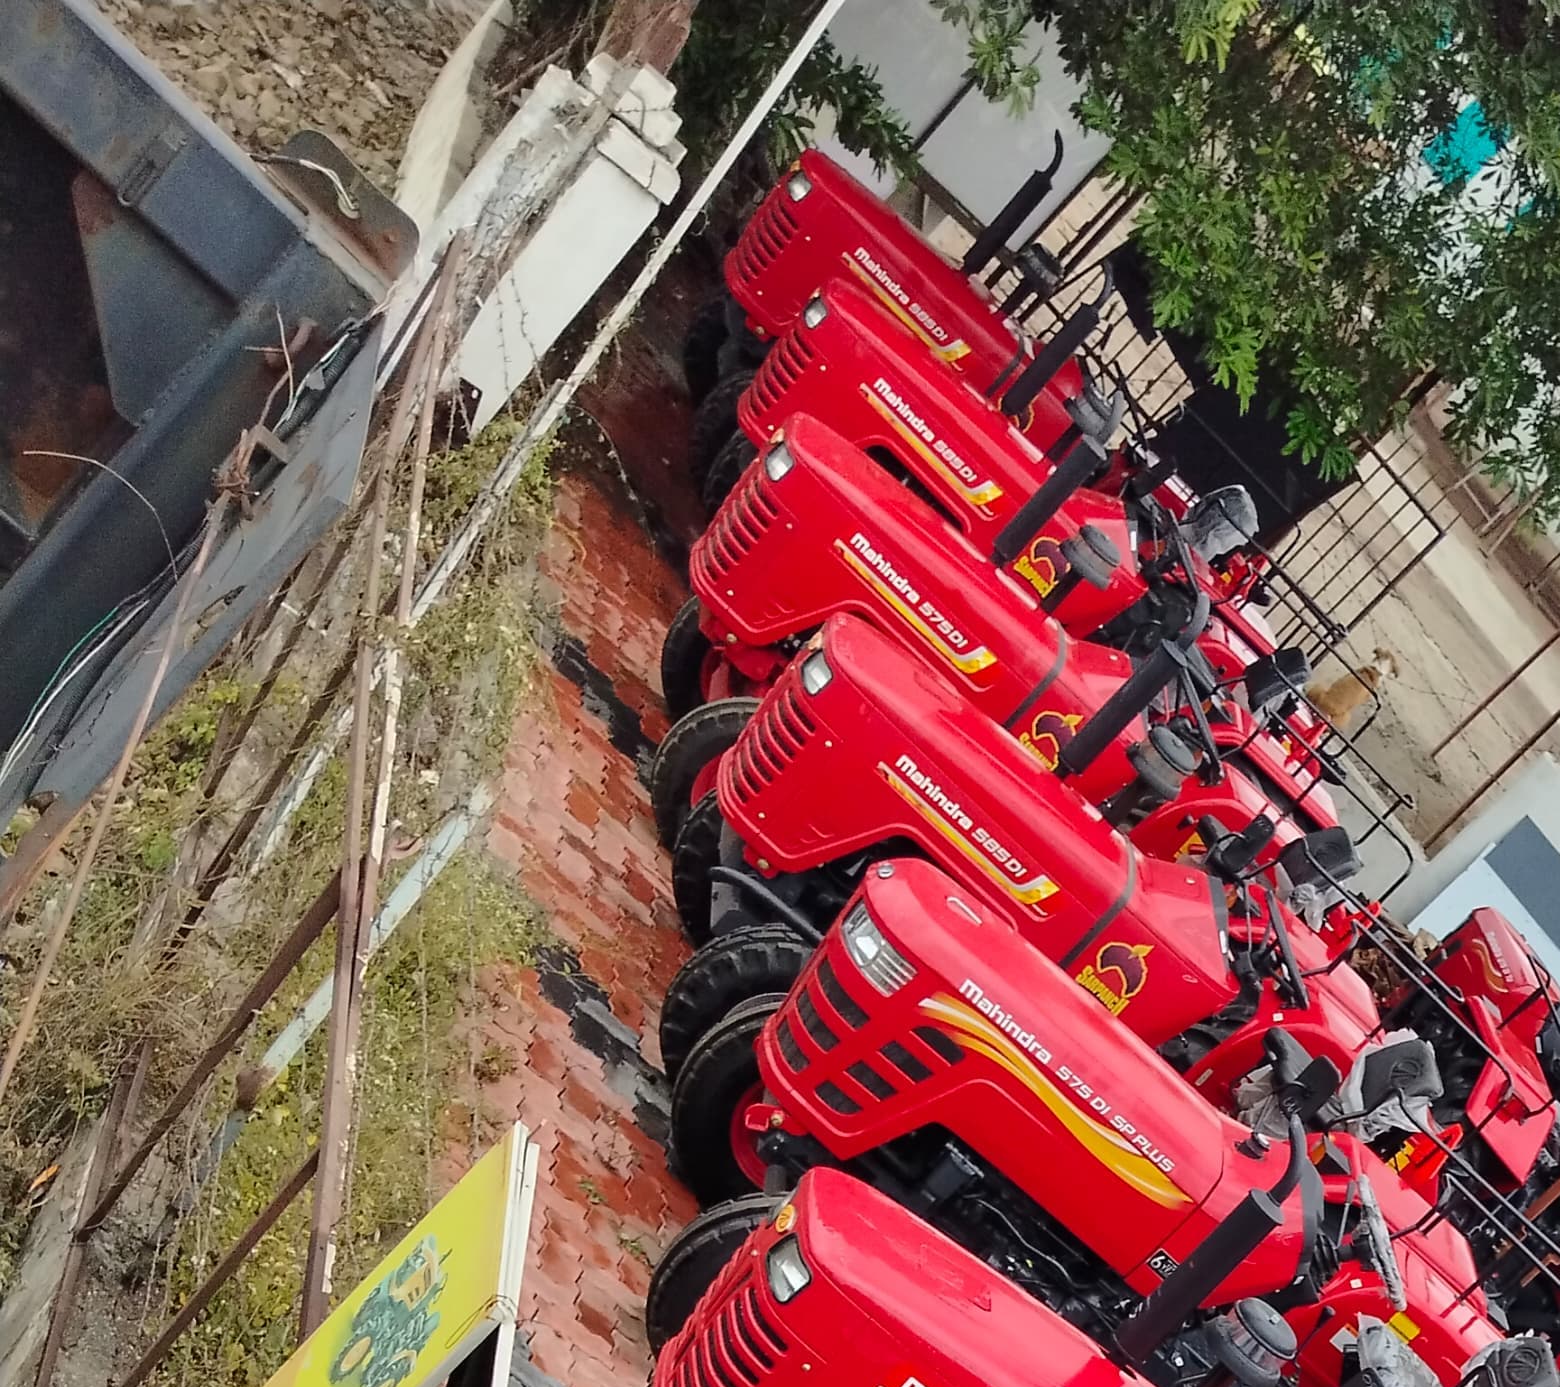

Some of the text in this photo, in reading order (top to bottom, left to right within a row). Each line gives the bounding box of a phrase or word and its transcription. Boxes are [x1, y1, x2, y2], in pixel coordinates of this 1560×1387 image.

[854, 247, 909, 304] Mahindra
[873, 378, 935, 442] Mahindra
[850, 533, 968, 648] Mahindra 575DI
[896, 755, 1028, 877] Mahindra 585DI
[959, 979, 1175, 1173] Mahindra 575 DI SP PLUS
